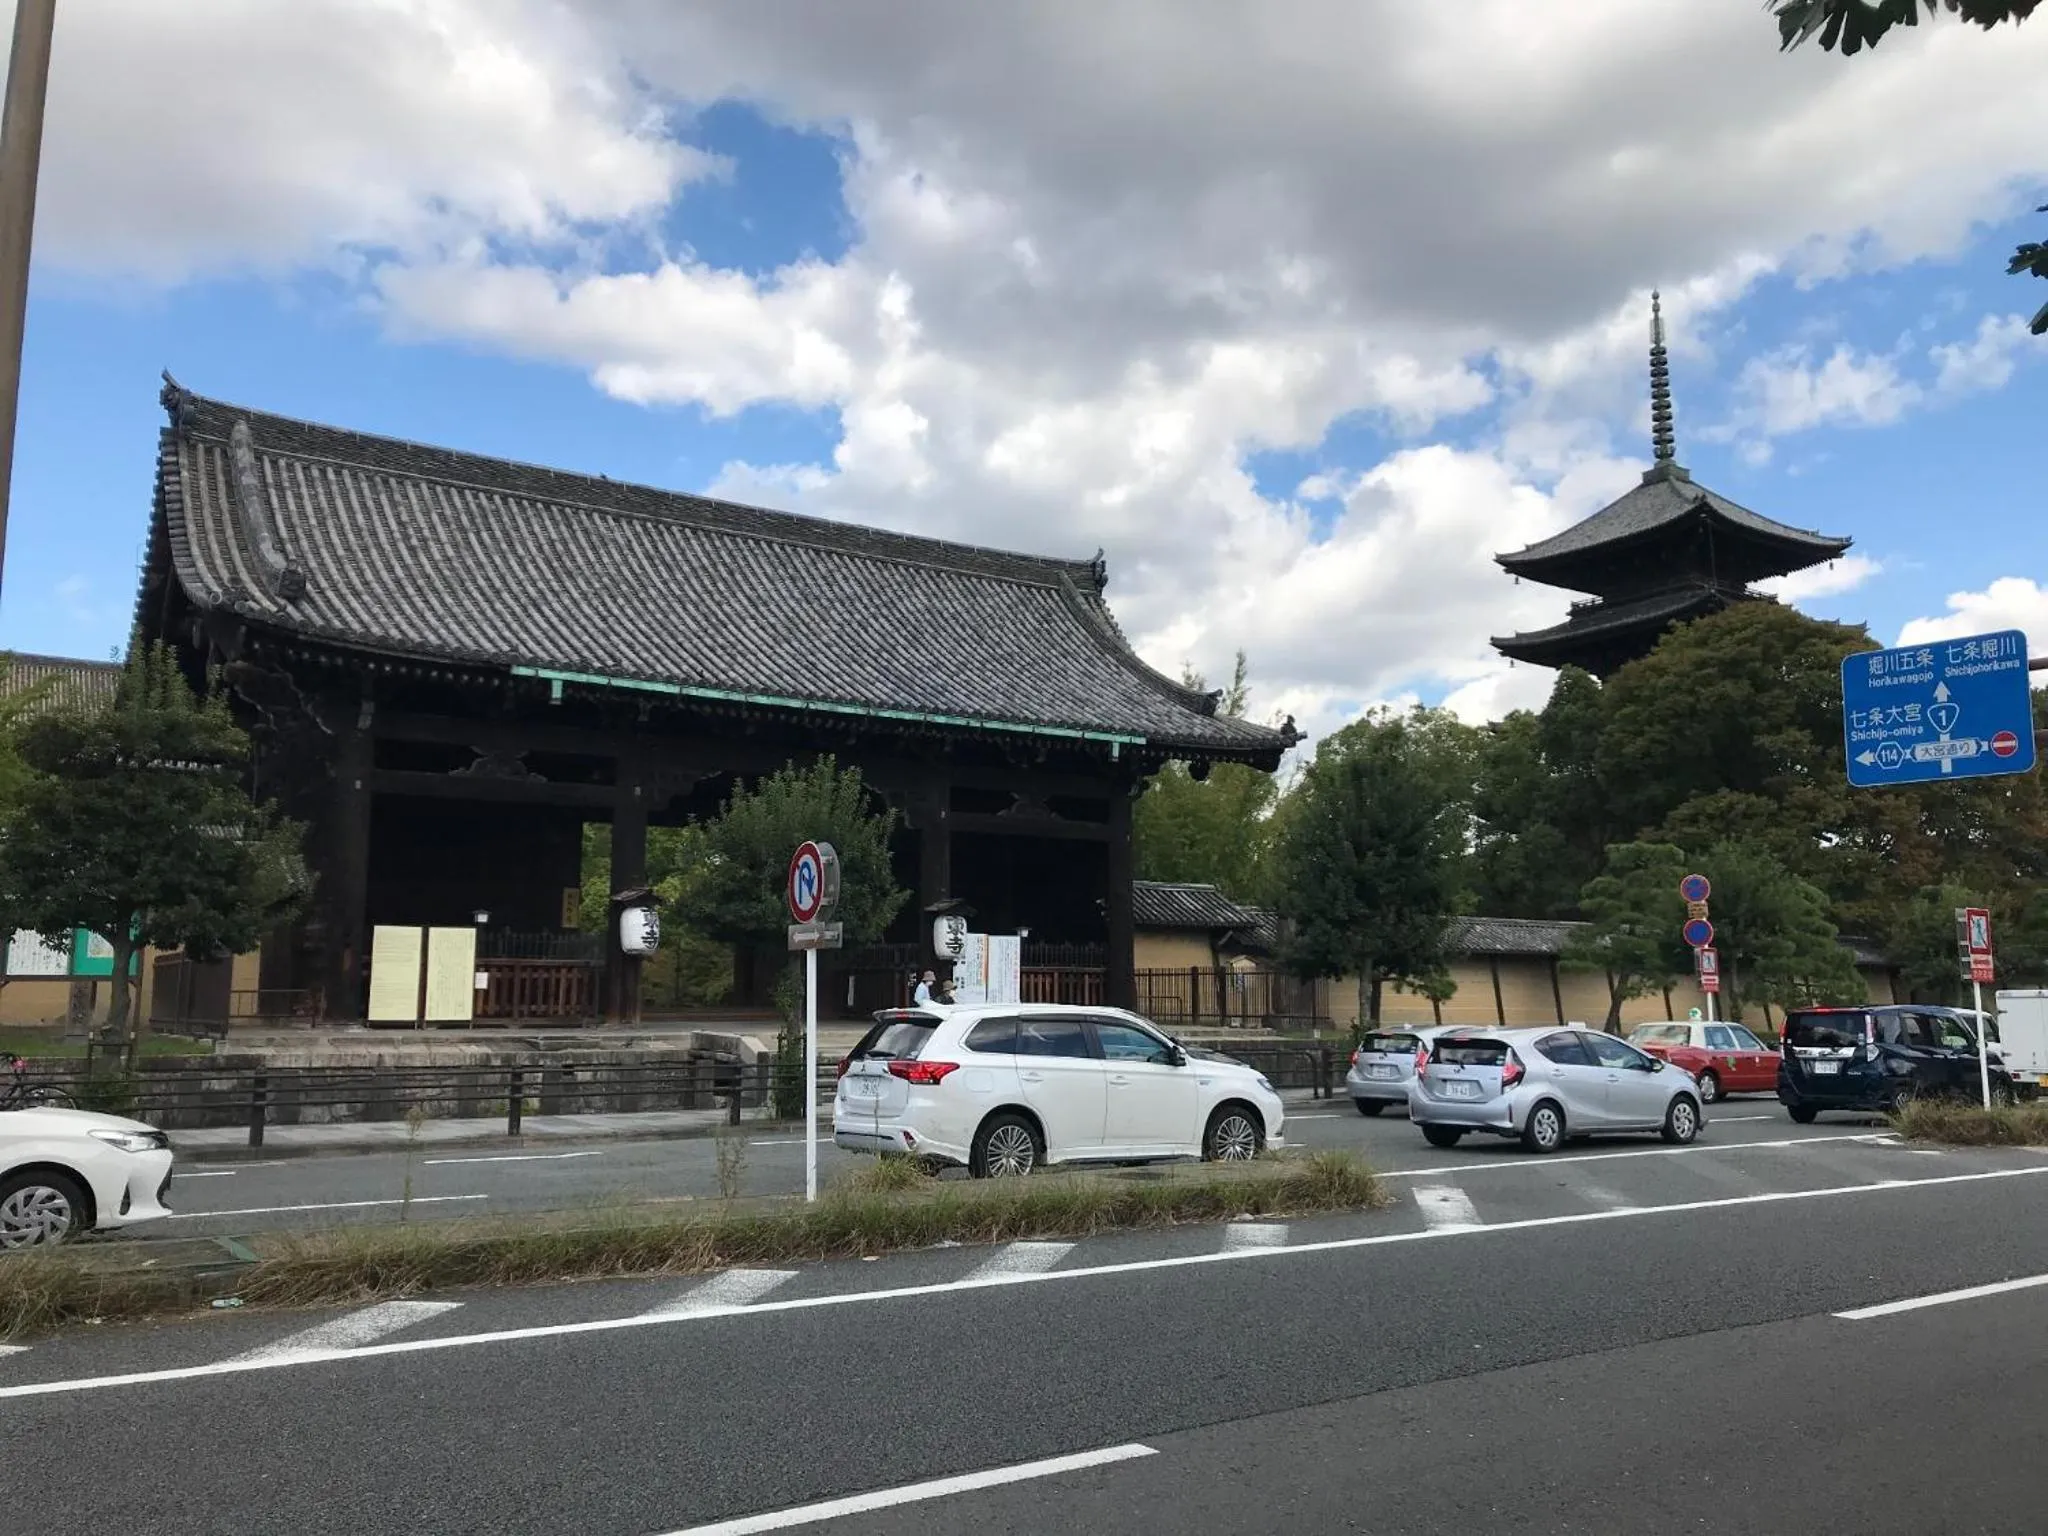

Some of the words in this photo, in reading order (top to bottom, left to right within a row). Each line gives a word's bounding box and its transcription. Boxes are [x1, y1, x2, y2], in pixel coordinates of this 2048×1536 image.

[1945, 636, 2016, 664] 七条堀川
[1868, 648, 1934, 675] 堀川五条
[1944, 659, 2020, 678] Shichijohorikawa
[1868, 671, 1934, 688] Horikawagojo
[1850, 703, 1922, 729] 七条大宮
[1938, 709, 1947, 727] 1
[1850, 724, 1924, 742] Shichijo-omiya
[1880, 749, 1898, 763] 114
[945, 917, 965, 955] 東寺
